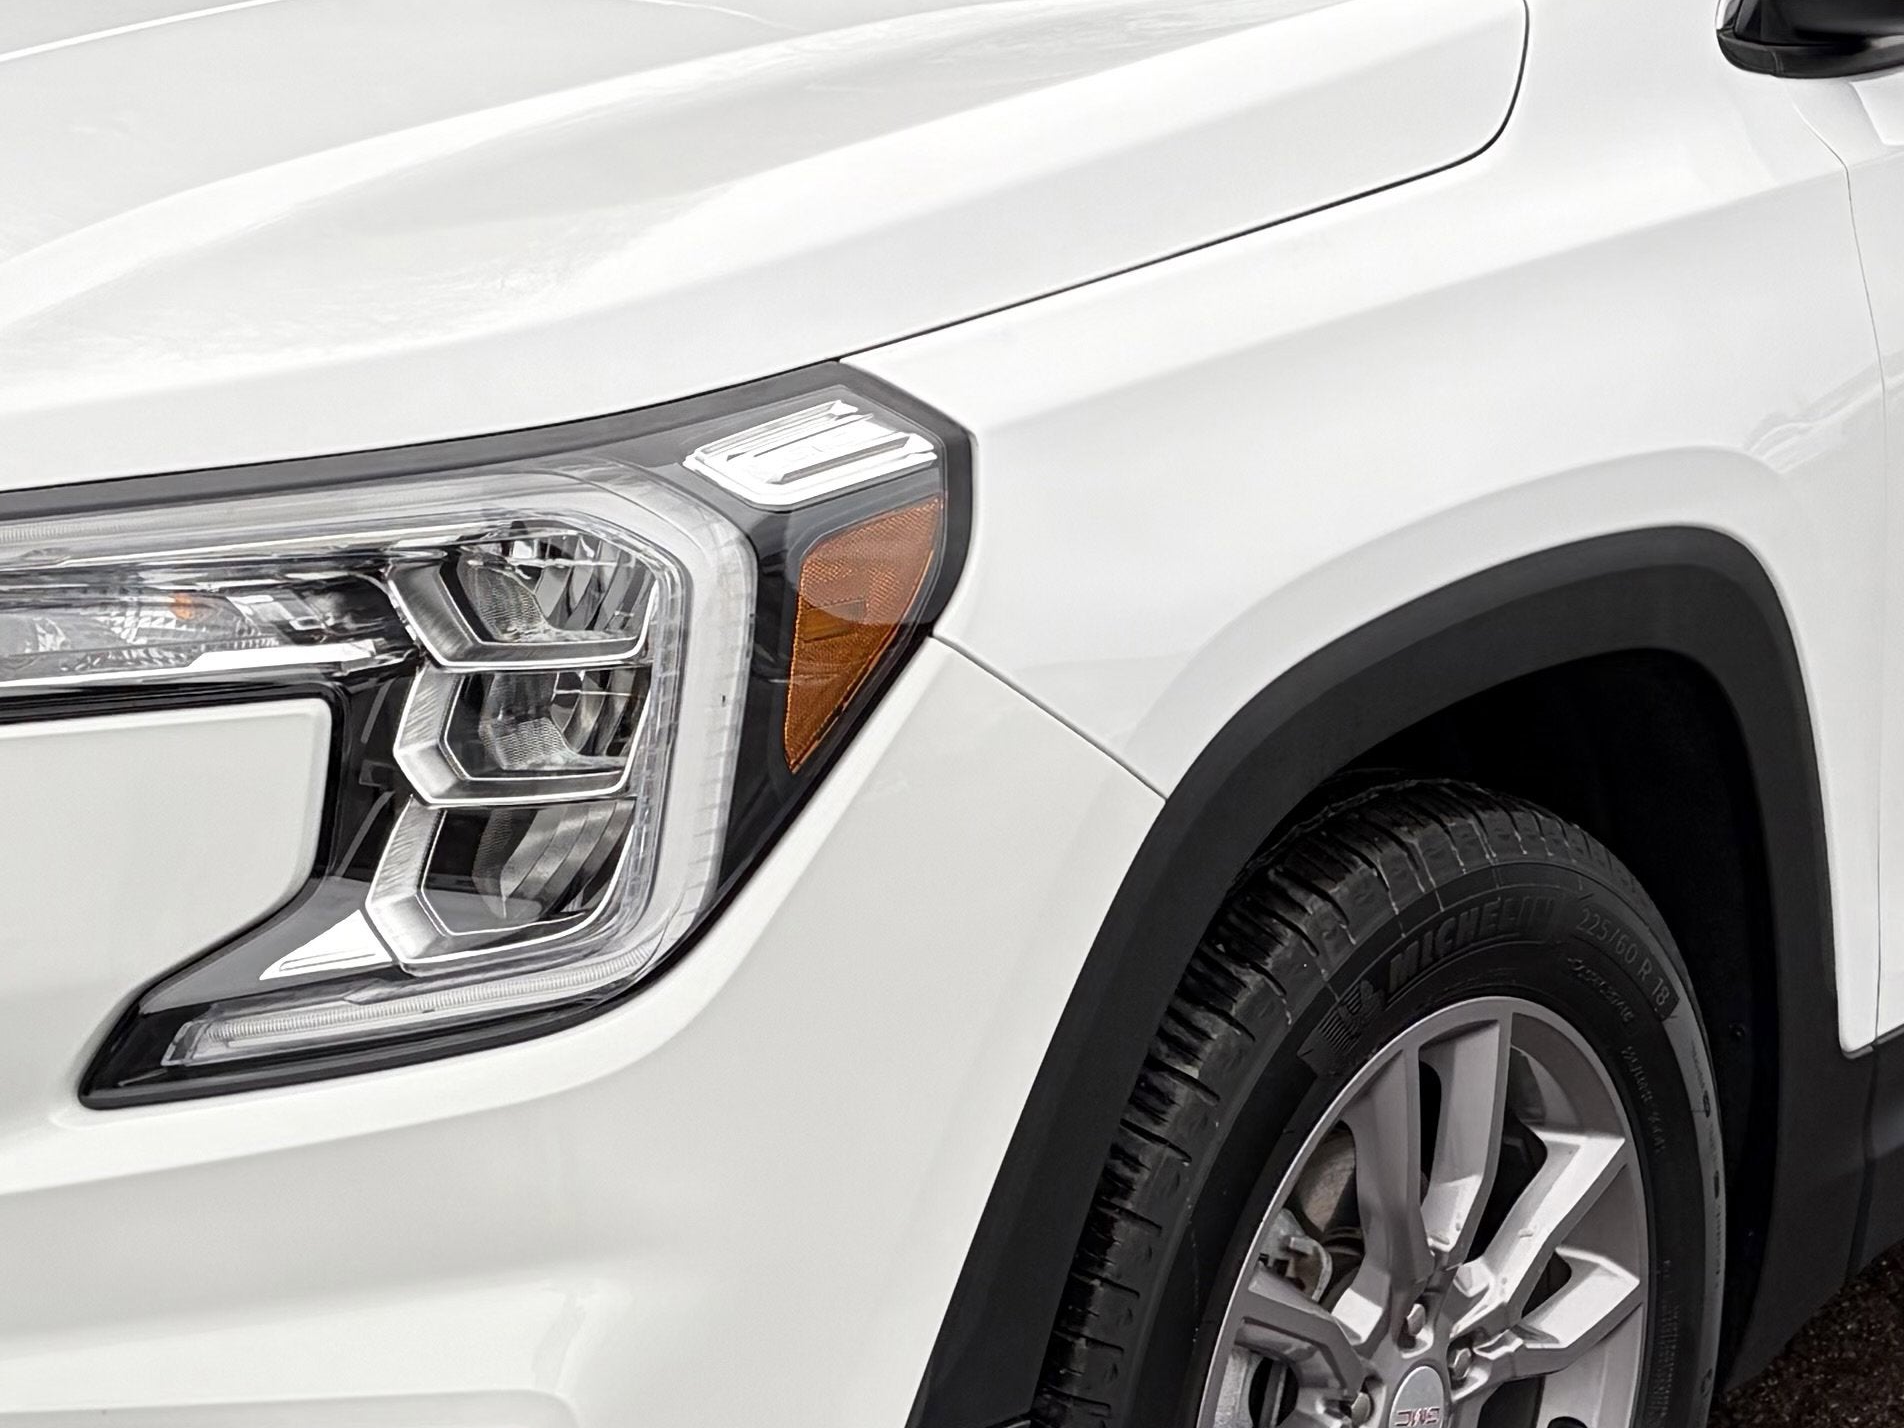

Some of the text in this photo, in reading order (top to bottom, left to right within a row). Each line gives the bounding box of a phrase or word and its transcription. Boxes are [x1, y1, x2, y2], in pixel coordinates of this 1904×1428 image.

[1386, 894, 1556, 994] MICHELIN
[1576, 908, 1669, 1006] 225/60 R 18
